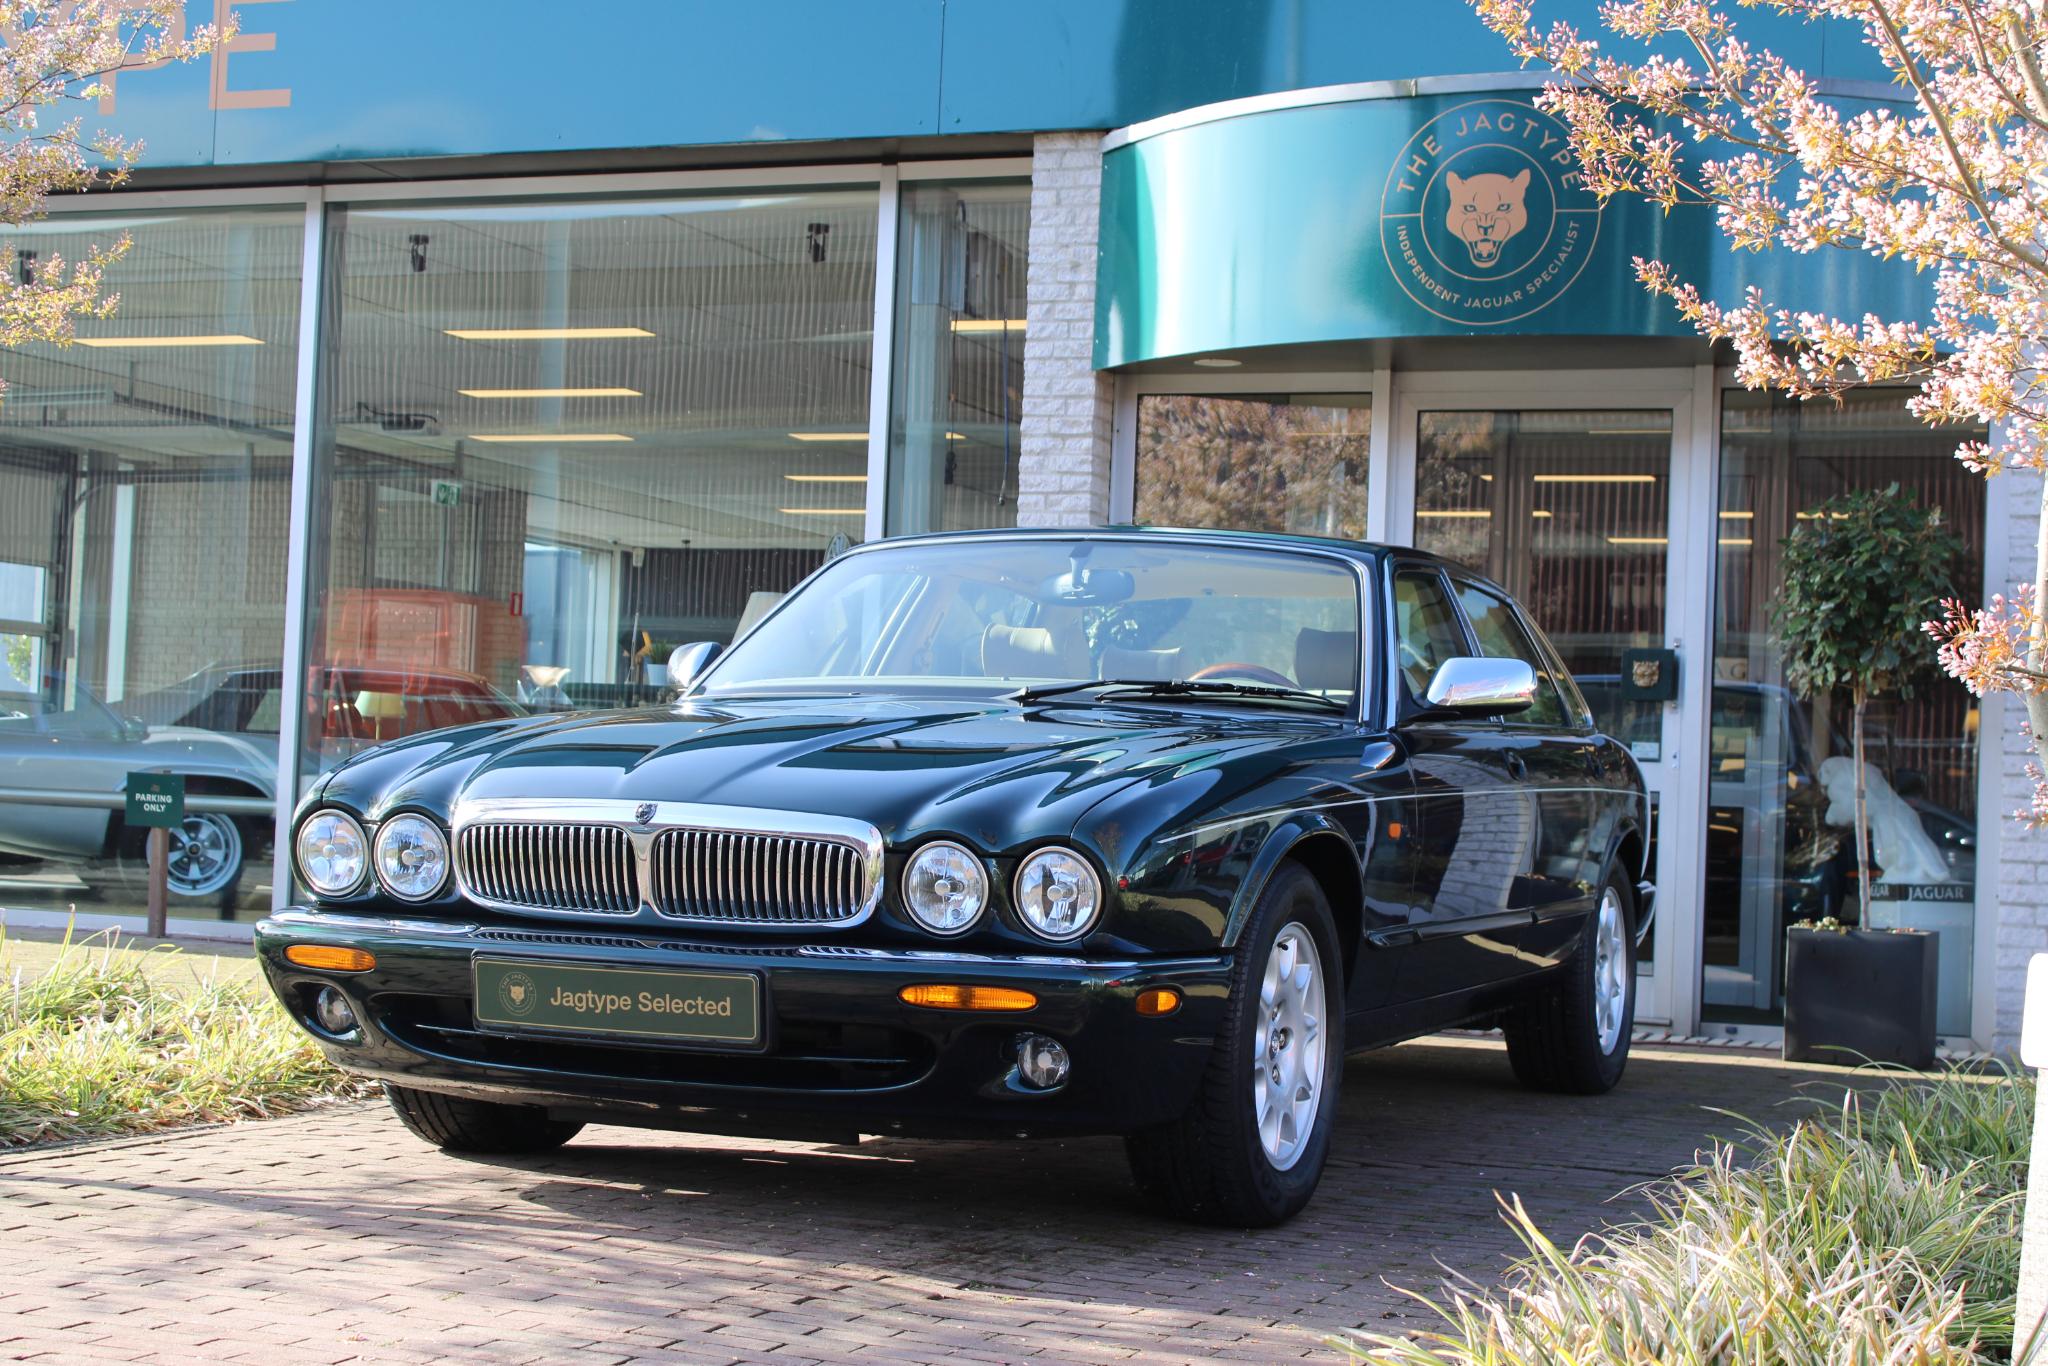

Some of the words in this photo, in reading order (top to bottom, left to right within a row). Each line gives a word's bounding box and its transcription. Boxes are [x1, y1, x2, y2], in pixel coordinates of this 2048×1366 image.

[1397, 135, 1444, 192] THE
[1456, 112, 1582, 189] JAGTYPE
[1397, 225, 1460, 304] INDEPENDENT
[1464, 290, 1523, 308] JAGUAR
[1526, 221, 1580, 294] SPECIALIST
[135, 793, 173, 803] PARKING
[143, 803, 166, 812] ONLY
[1908, 886, 1964, 900] JAGUAR
[550, 987, 632, 1014] Jagtype
[638, 992, 731, 1016] Selected
